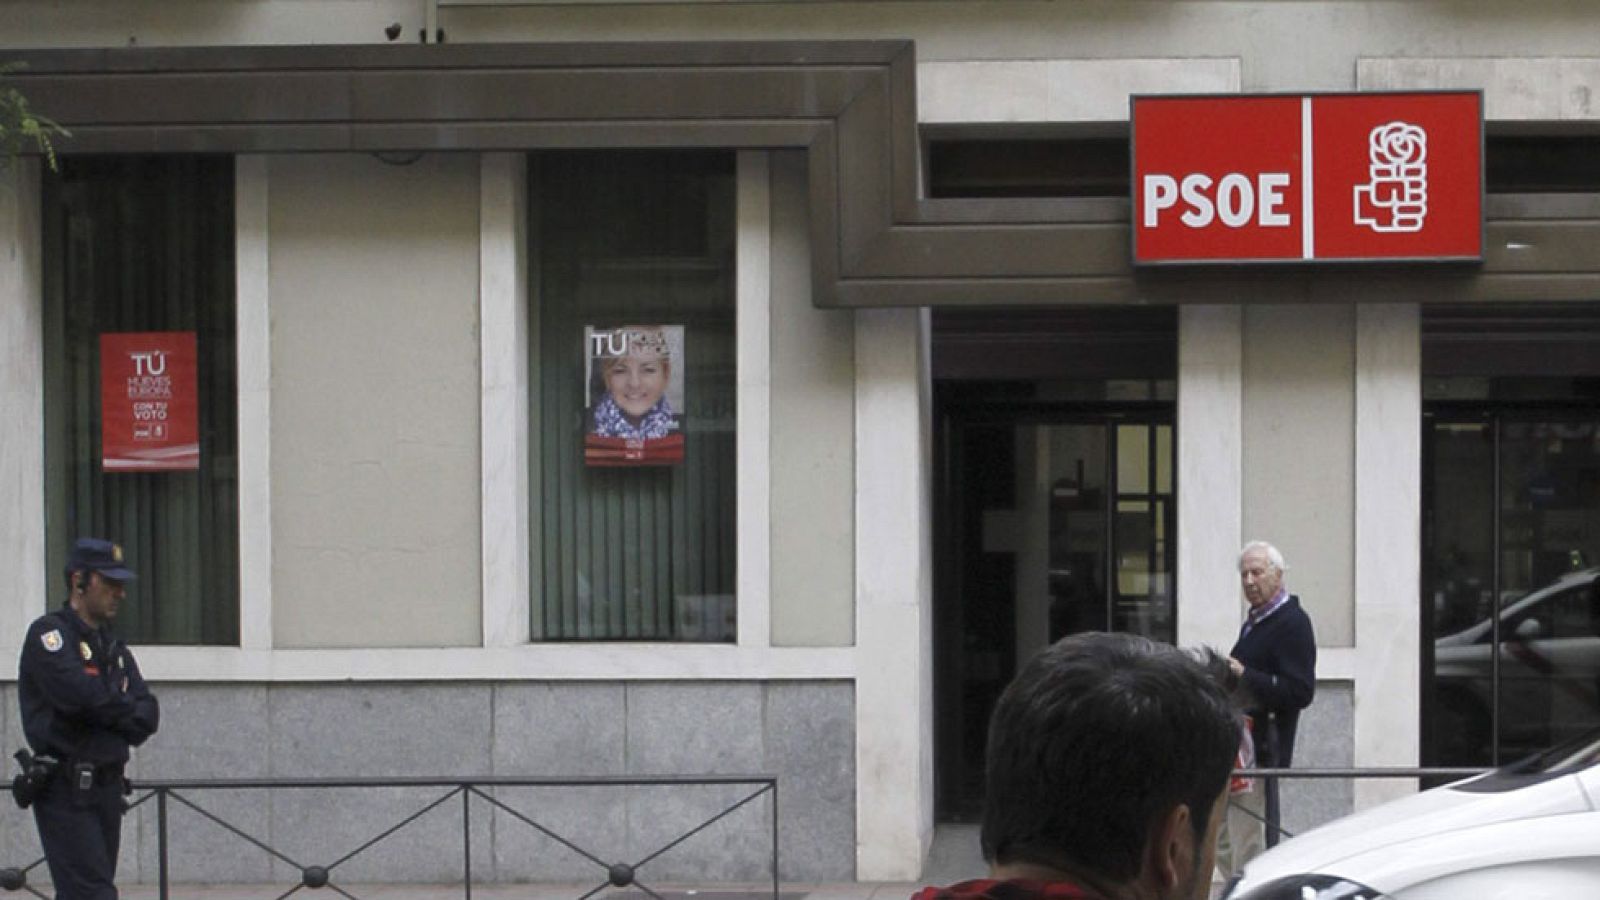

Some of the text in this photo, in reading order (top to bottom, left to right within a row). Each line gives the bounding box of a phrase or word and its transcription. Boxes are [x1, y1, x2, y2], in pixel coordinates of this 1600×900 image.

[1143, 172, 1291, 228] PSOE
[590, 329, 627, 356] TÚ
[130, 350, 166, 376] TÚ
[133, 410, 168, 420] VOTO
